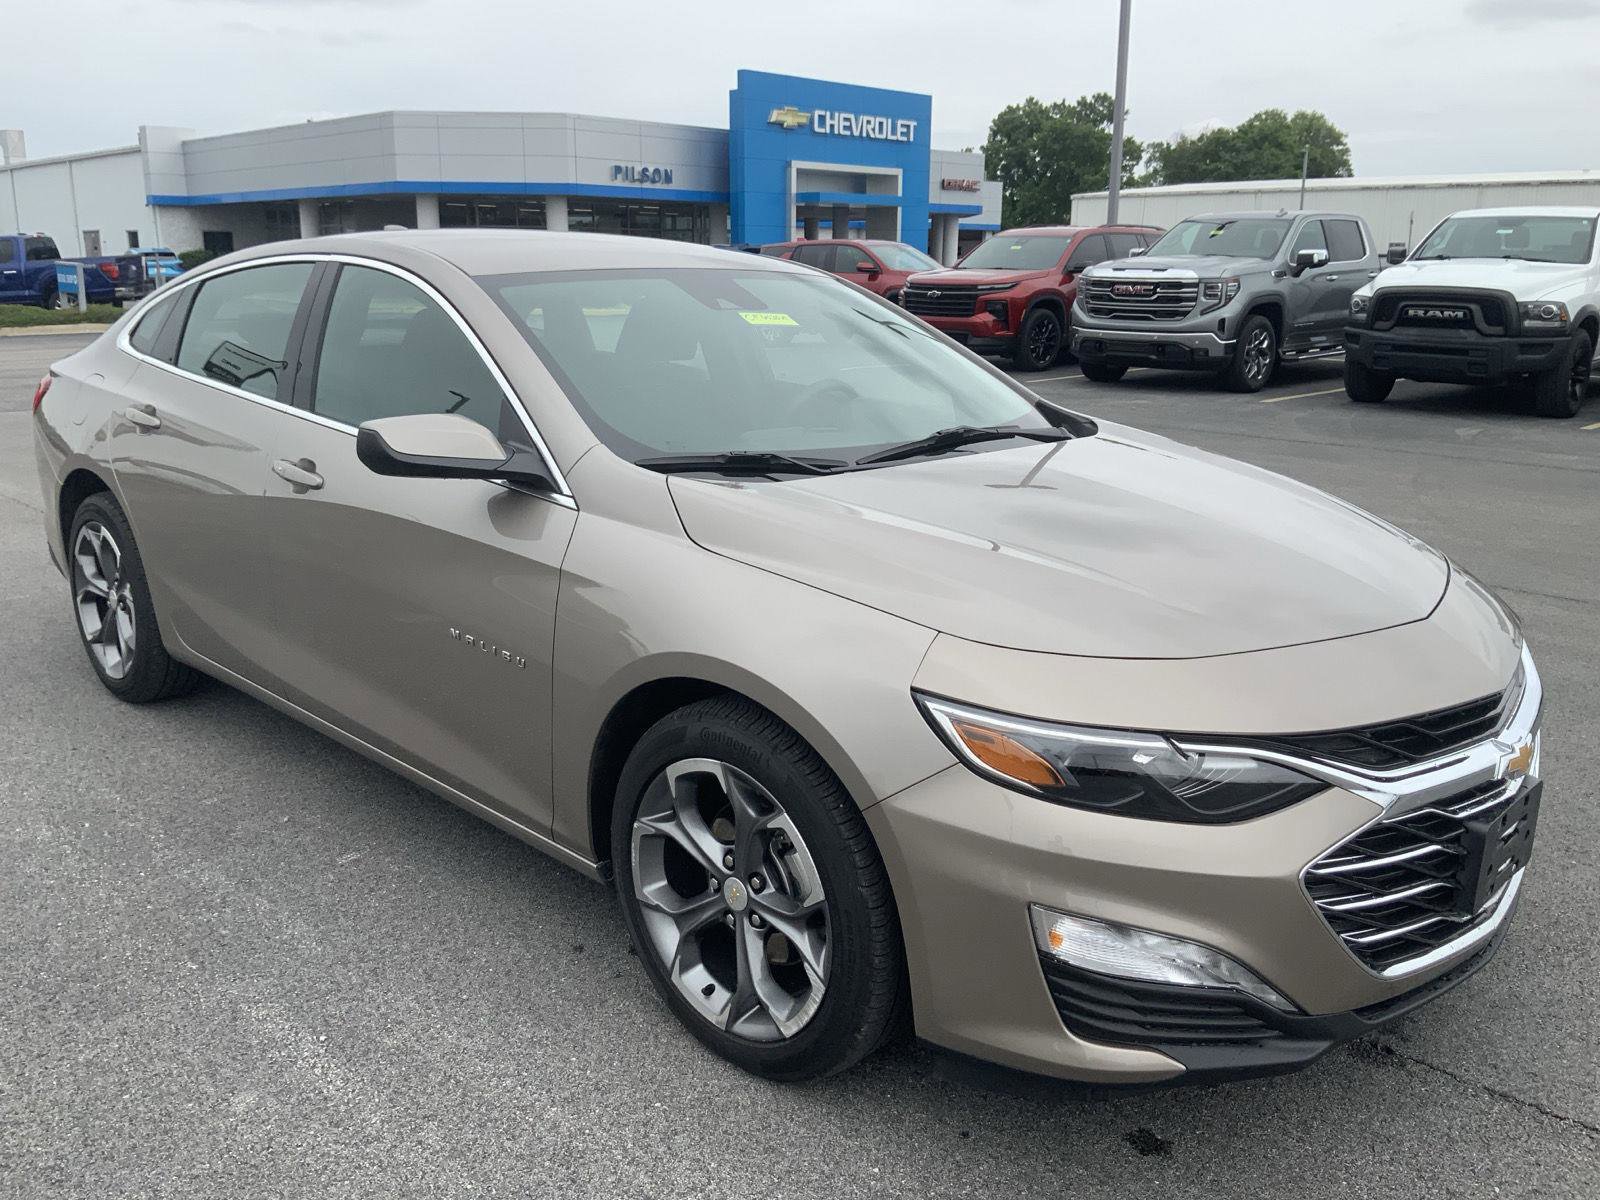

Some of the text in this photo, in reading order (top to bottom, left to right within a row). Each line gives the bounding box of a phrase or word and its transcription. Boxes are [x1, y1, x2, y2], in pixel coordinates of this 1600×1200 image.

[813, 109, 918, 142] CHEVROLET
[611, 164, 674, 186] PILSON
[1112, 284, 1154, 295] GMC
[1408, 309, 1464, 319] RAM
[449, 627, 527, 670] MALIBU
